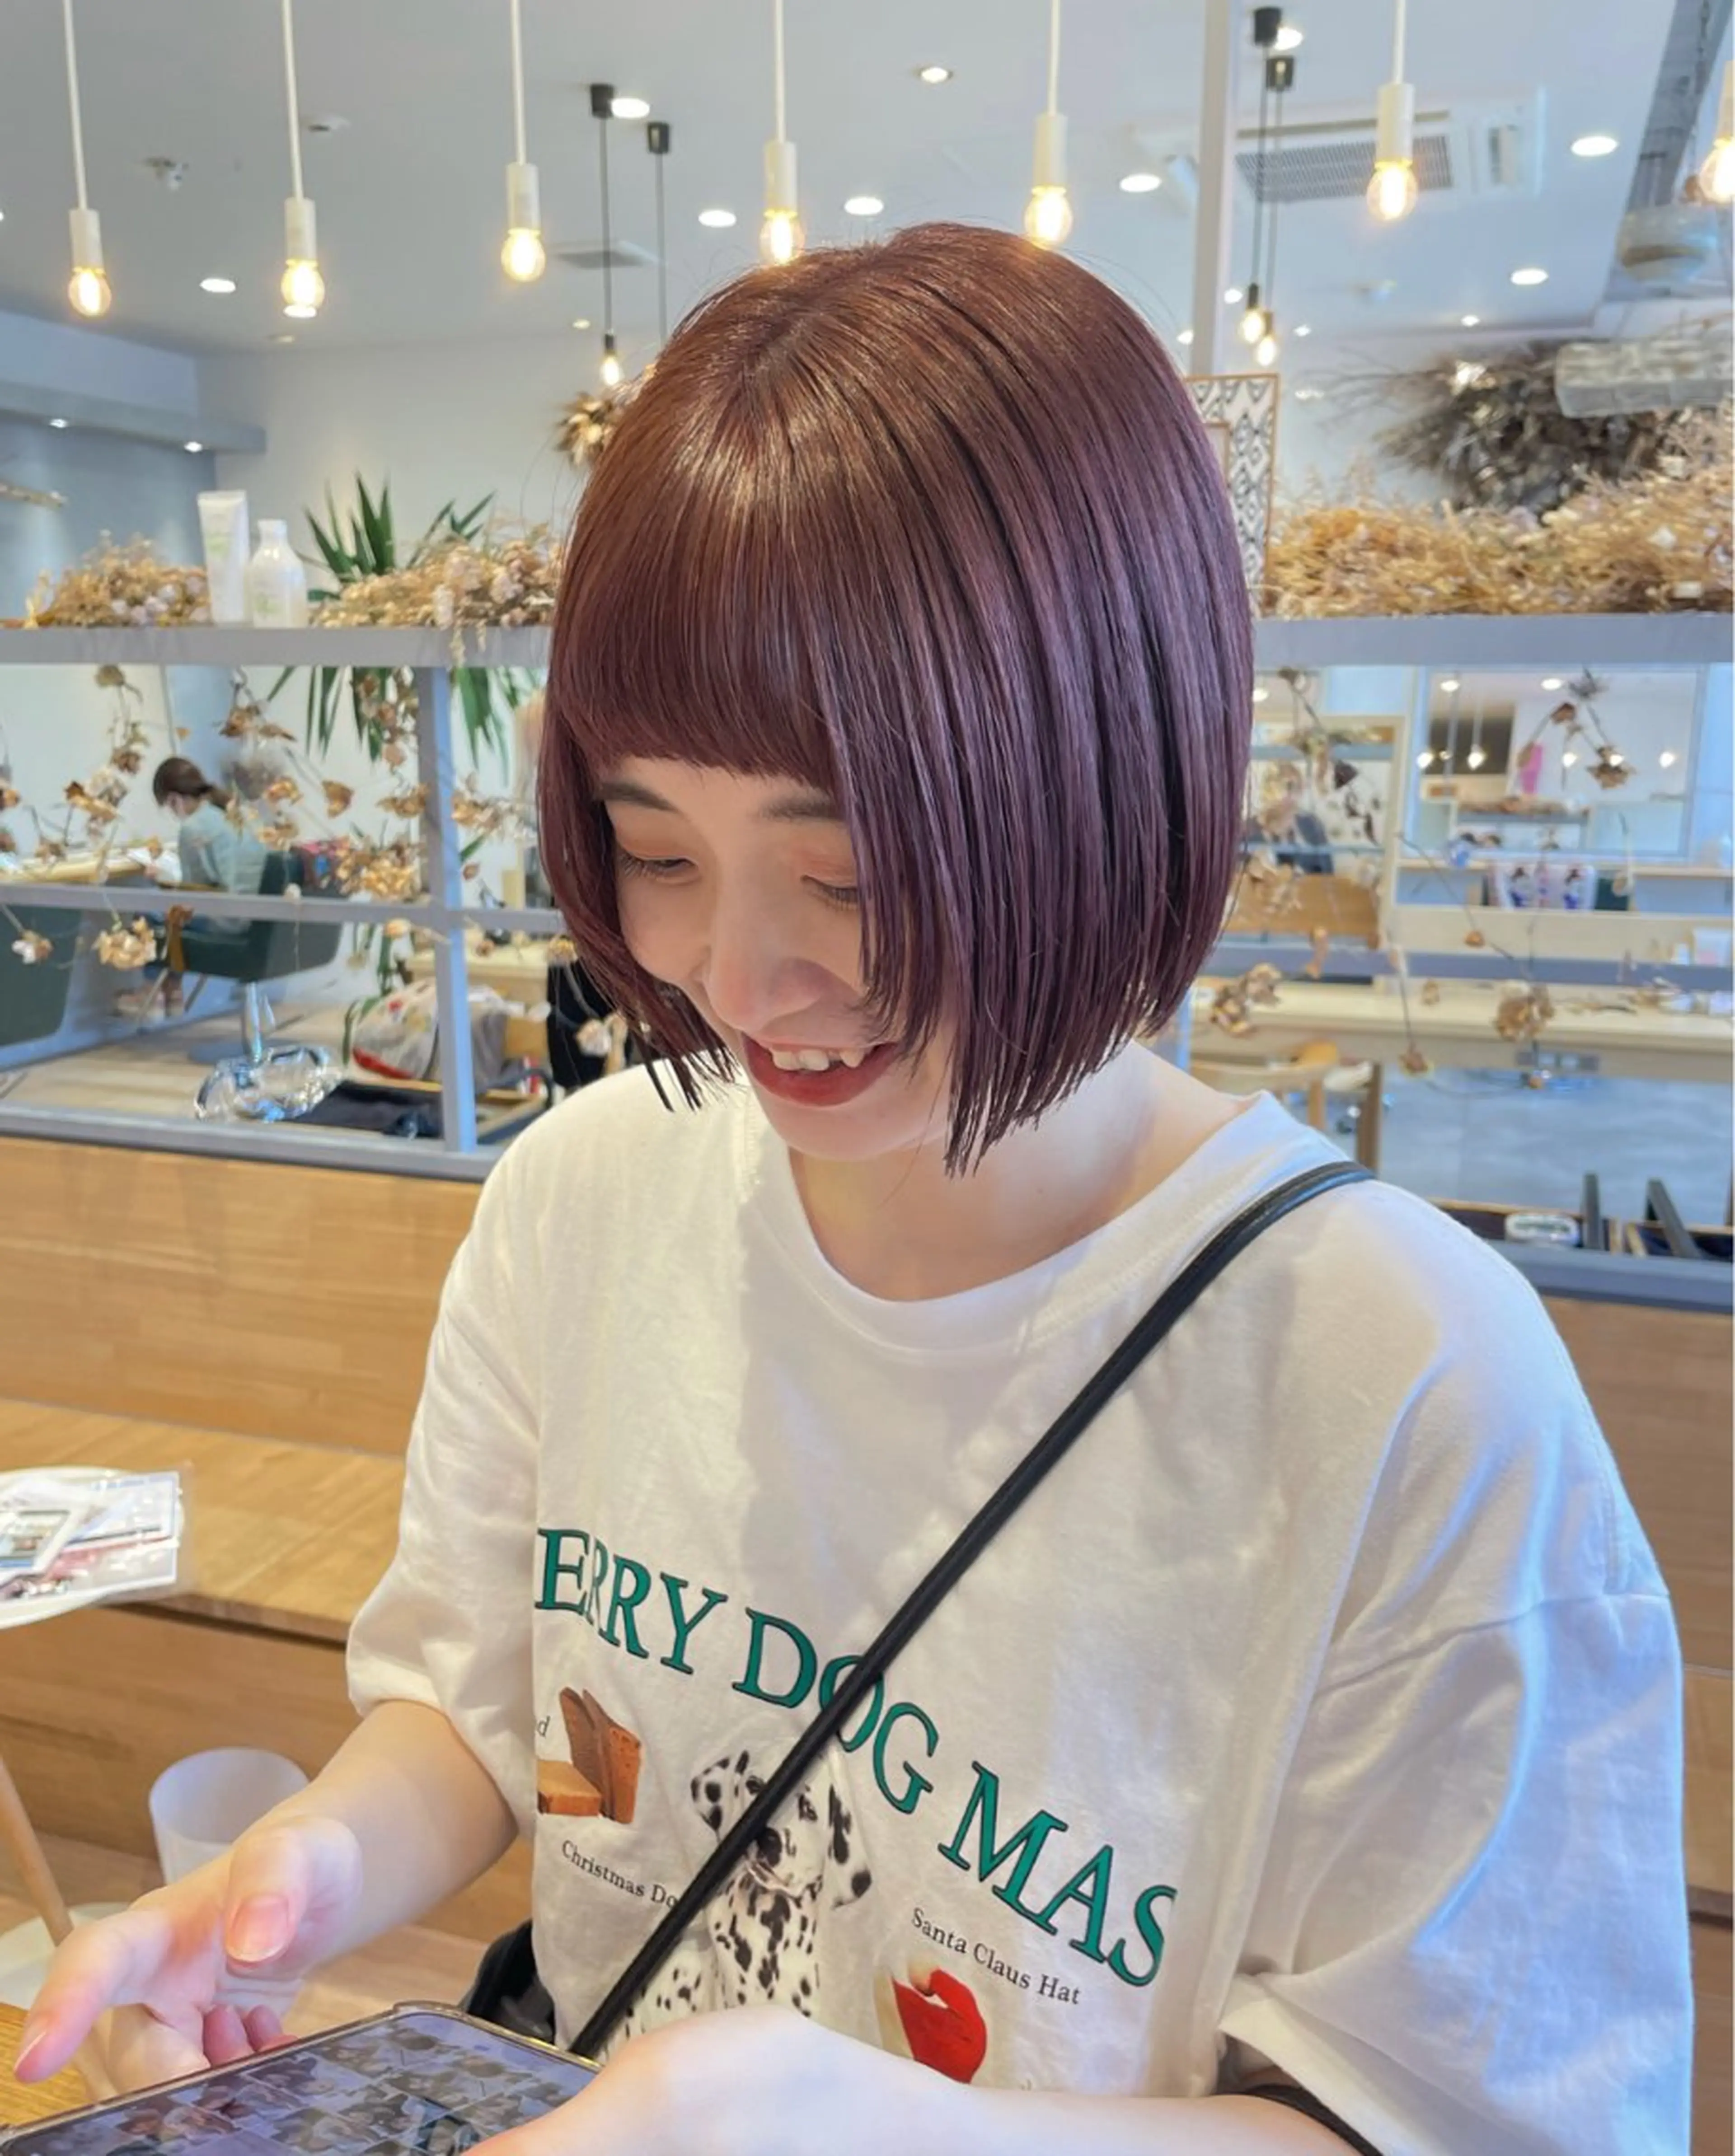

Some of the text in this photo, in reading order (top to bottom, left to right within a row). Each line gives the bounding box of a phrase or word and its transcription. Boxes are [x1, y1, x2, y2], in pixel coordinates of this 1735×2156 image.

[732, 1607, 938, 1815] DOG
[938, 1760, 1178, 1987] MAS
[562, 1839, 645, 1897] Christmas
[911, 1907, 1081, 2005] Santa Claus Hat
